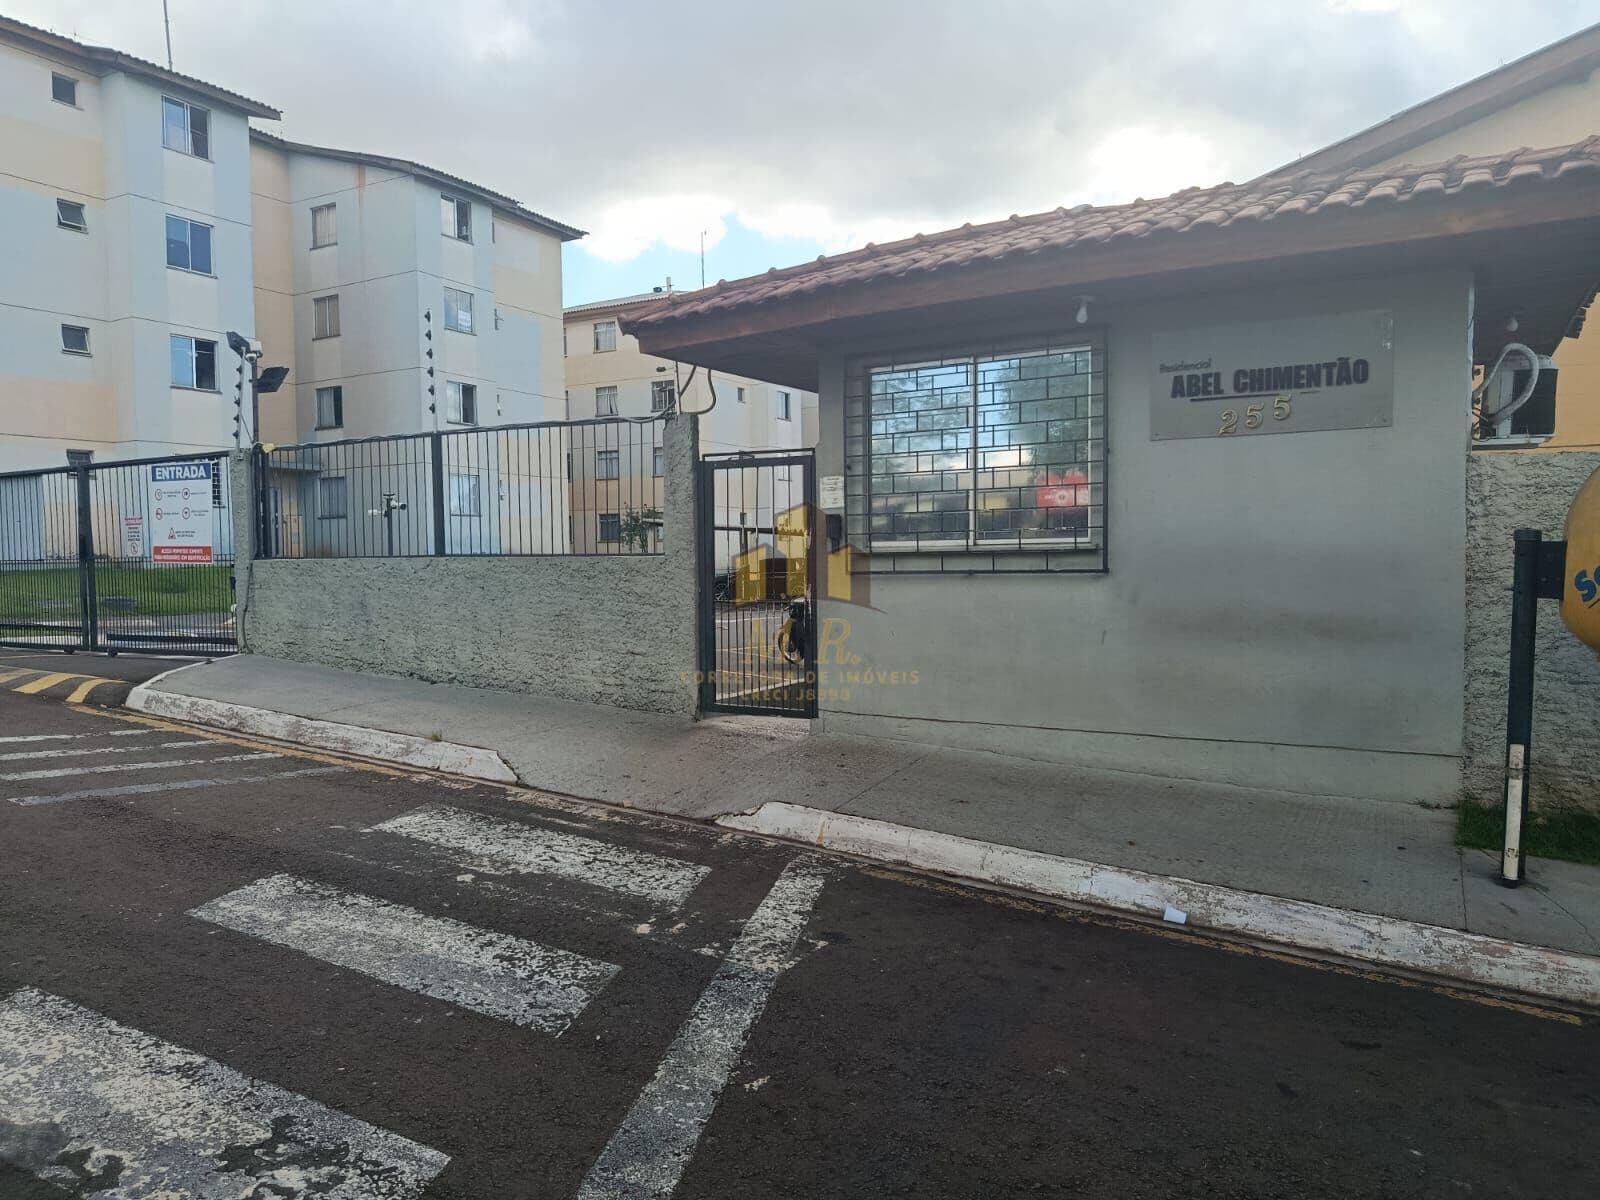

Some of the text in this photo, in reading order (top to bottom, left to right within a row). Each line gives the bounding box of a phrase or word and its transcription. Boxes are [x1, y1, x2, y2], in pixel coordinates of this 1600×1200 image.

[1159, 358, 1213, 374] Residencial
[1170, 356, 1370, 399] ABEL CHIMENTÃO
[1217, 393, 1292, 436] 255
[155, 465, 207, 480] ENTRADA
